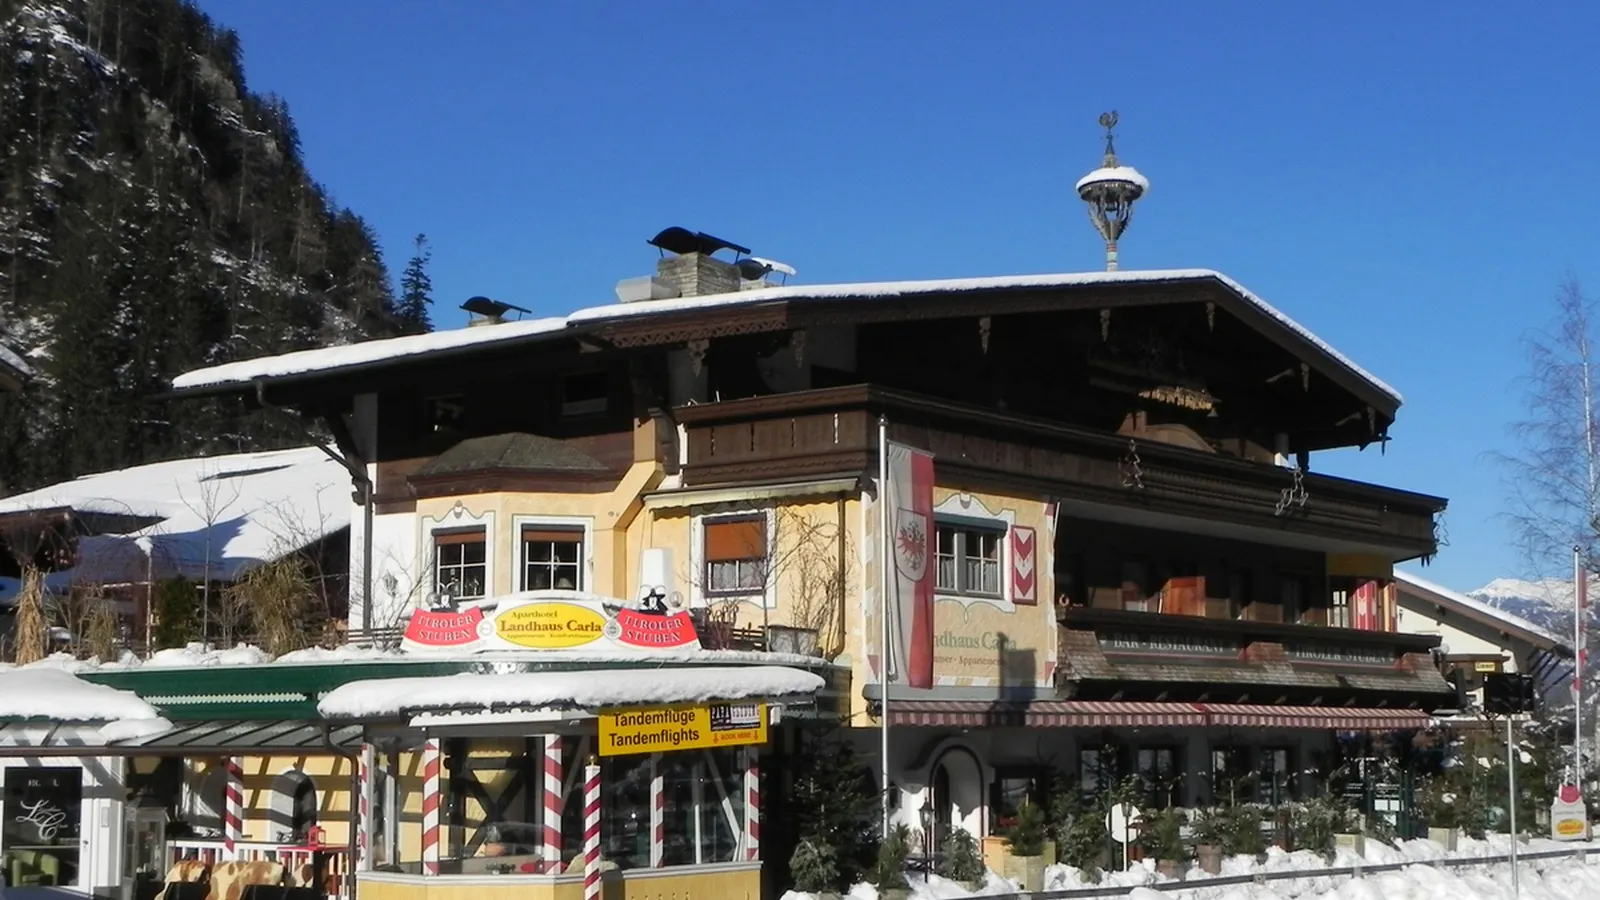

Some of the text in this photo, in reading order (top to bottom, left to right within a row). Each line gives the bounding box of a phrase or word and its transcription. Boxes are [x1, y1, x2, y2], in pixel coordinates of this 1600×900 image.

[511, 610, 558, 619] Aparthotel
[417, 615, 475, 629] TIROLER
[500, 620, 603, 632] Landhaus Carla
[624, 615, 685, 630] TIROLER
[418, 628, 473, 641] STUBEN
[626, 629, 681, 643] STUBEN
[1113, 632, 1140, 649] BAR
[1148, 634, 1225, 653] RESTAURANT
[1295, 644, 1342, 661] TIROLER
[609, 728, 700, 747] Tandemflights
